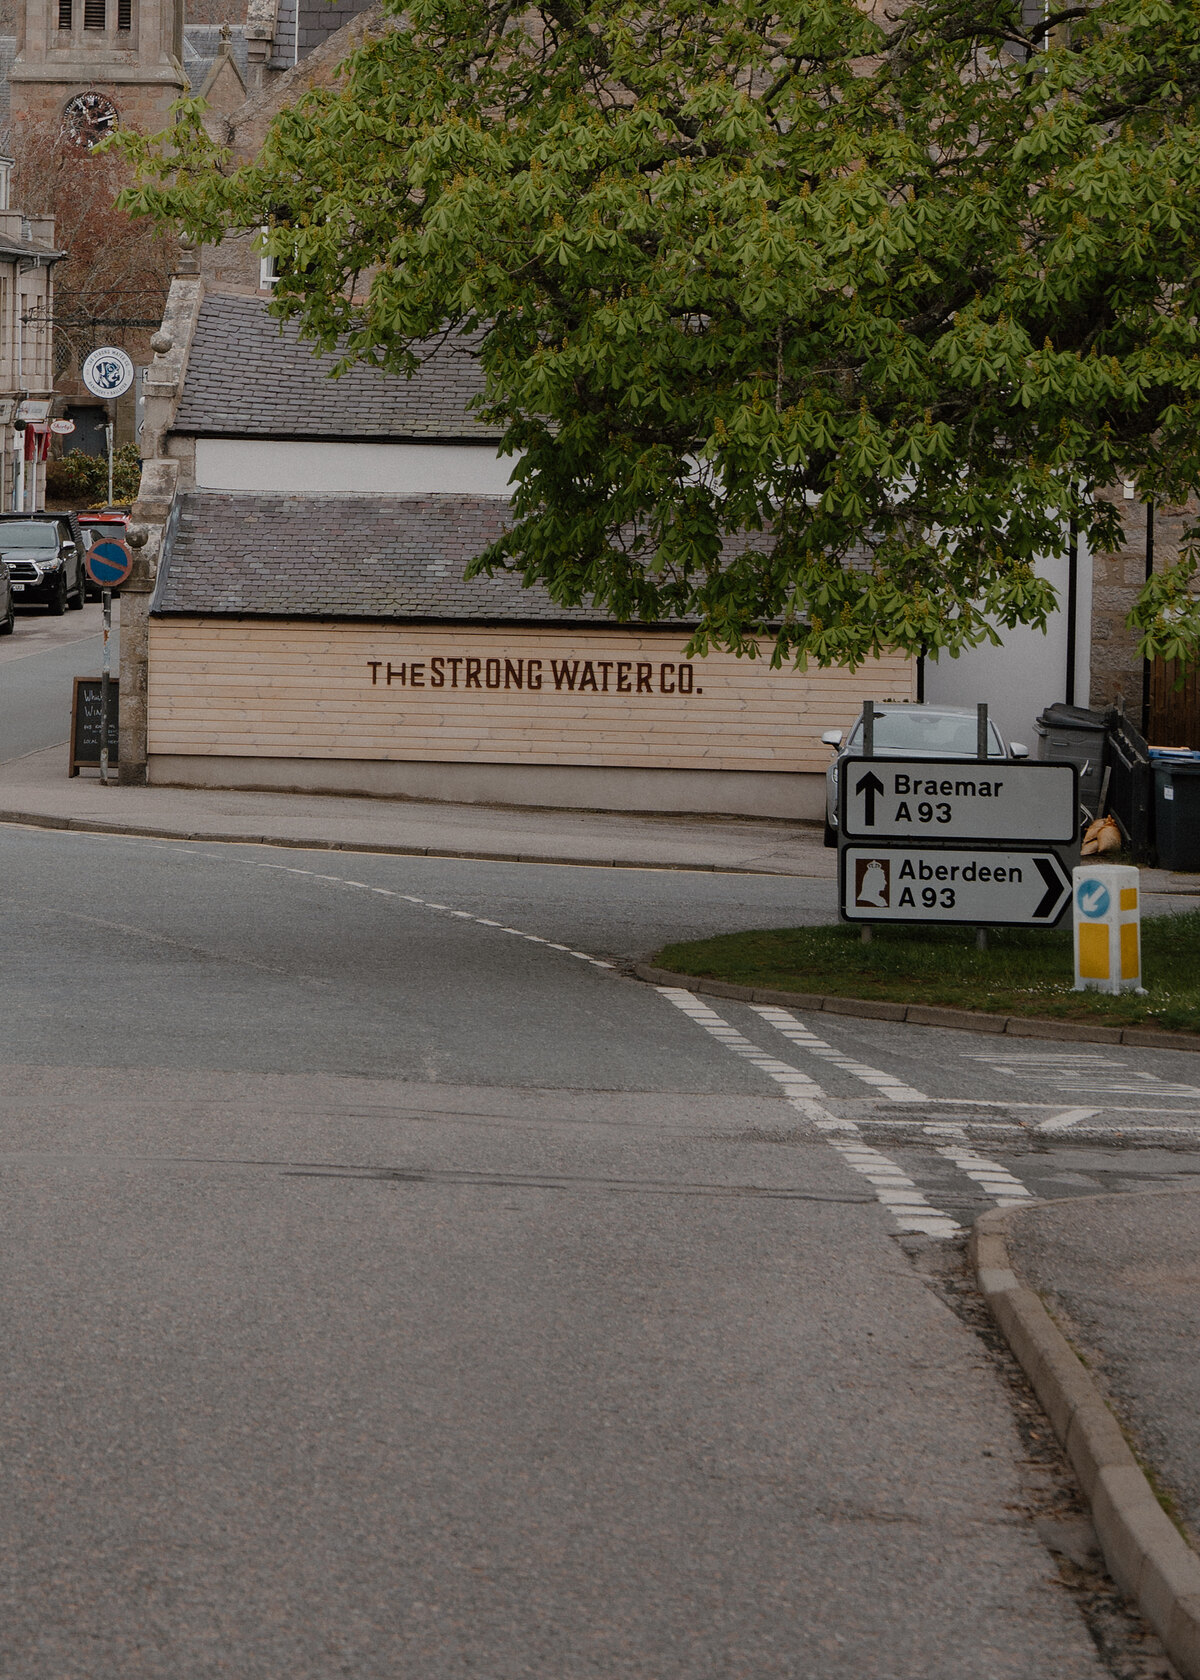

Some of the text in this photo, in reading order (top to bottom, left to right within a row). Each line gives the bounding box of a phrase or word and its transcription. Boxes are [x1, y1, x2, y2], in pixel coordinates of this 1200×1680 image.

[367, 657, 703, 694] THE STRONG WATER CO.
[894, 774, 1004, 797] Braemar
[894, 801, 952, 823] A93
[898, 859, 1023, 883] Aberdeen
[898, 886, 956, 909] A93
